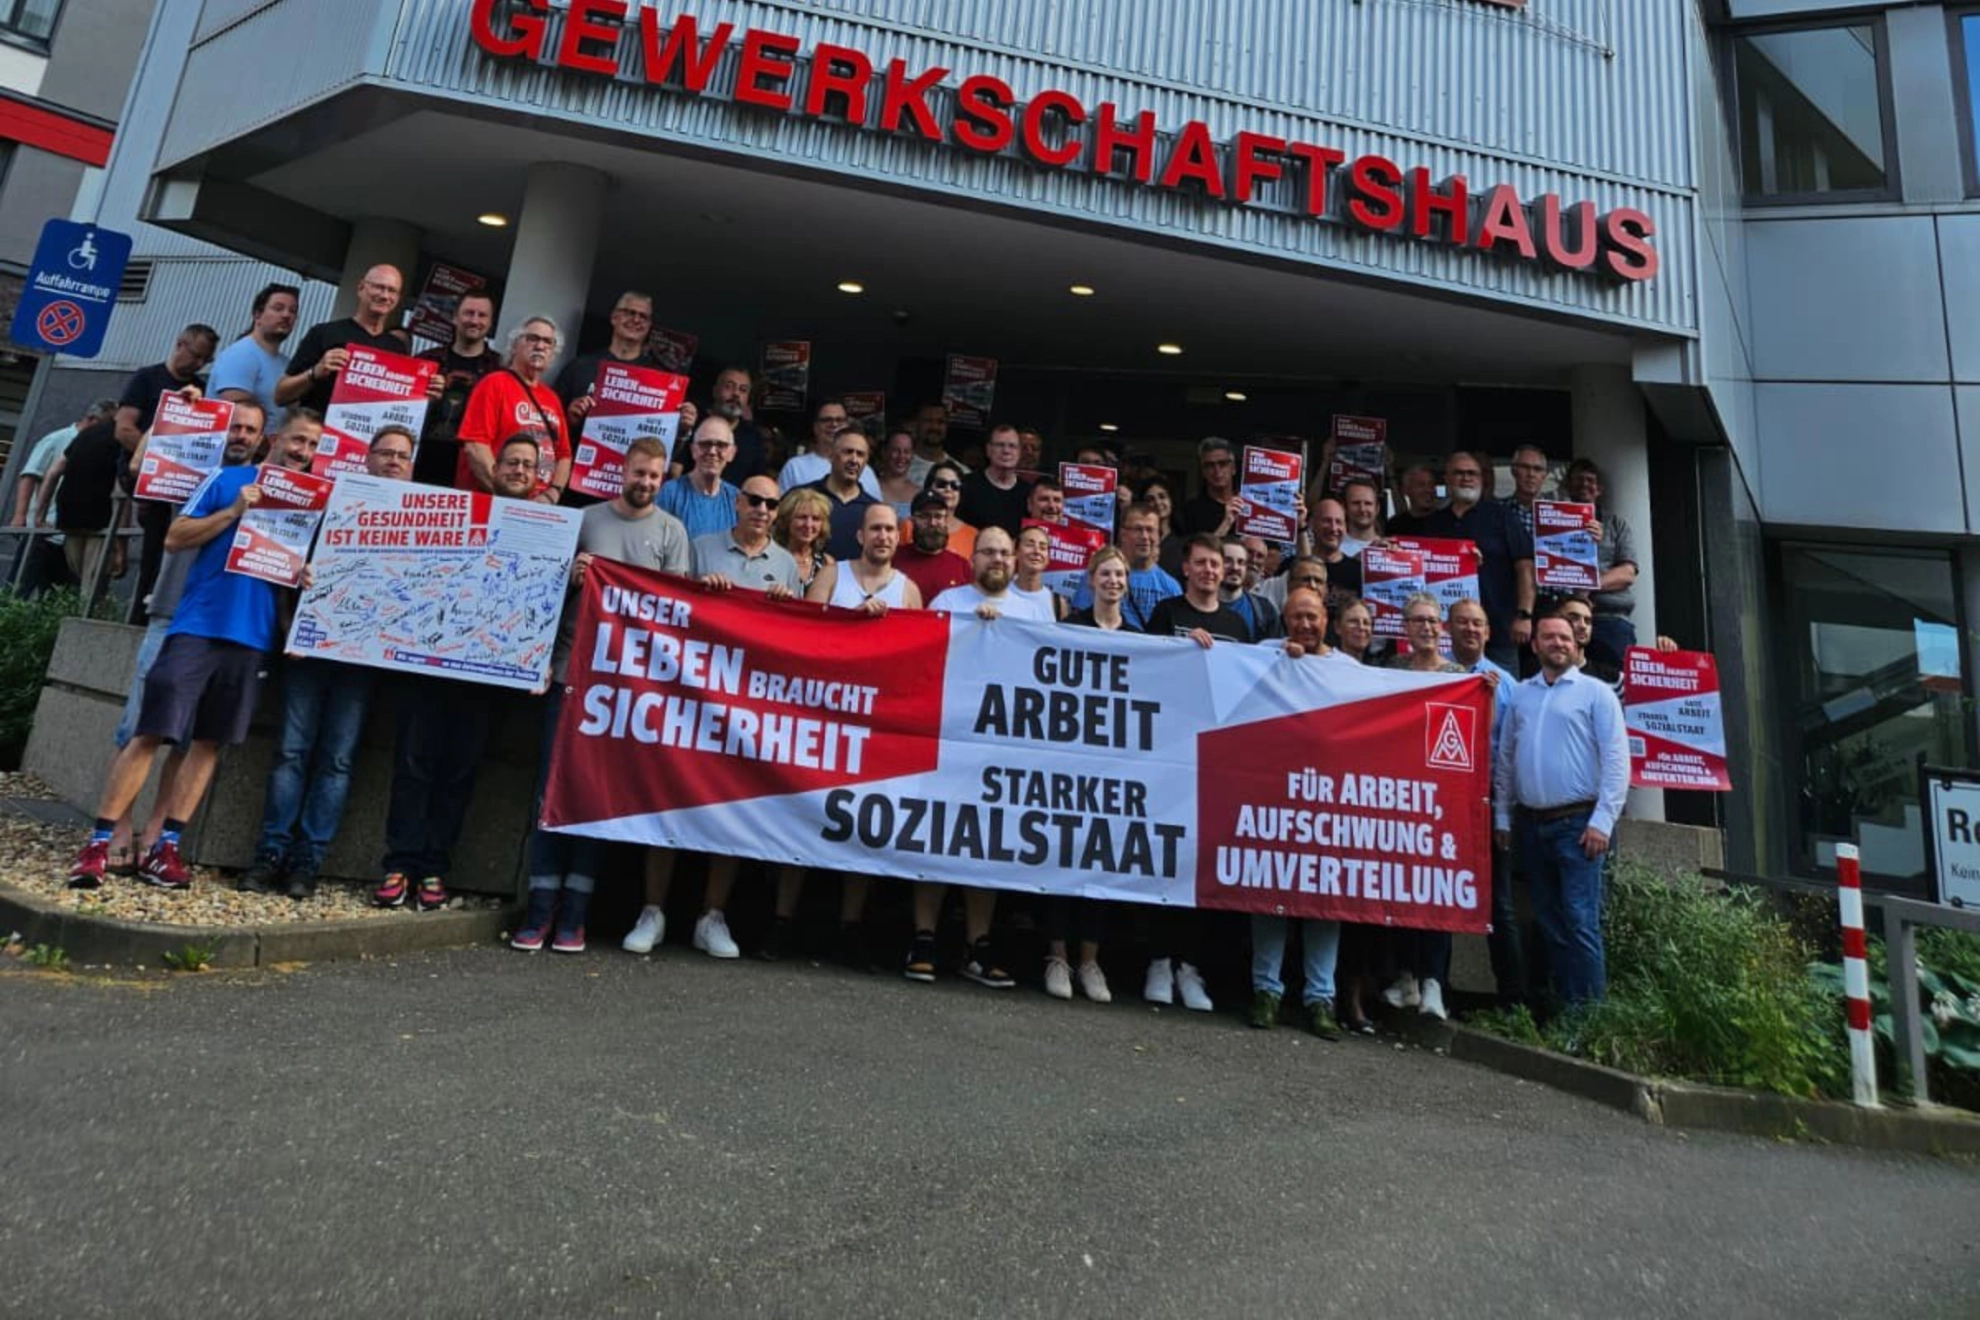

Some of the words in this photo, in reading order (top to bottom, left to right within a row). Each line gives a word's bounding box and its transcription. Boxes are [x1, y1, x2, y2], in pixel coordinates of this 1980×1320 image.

[470, 0, 1658, 281] GEWERKSCHAFTSHAUS
[35, 271, 110, 298] Auffahrrampe
[349, 360, 386, 376] LEBEN
[345, 373, 413, 396] SICHERHEIT
[604, 376, 639, 391] LEBEN
[601, 387, 665, 409] SICHERHEIT
[402, 493, 469, 510] UNSERE
[357, 511, 467, 528] GESUNDHEIT
[325, 529, 354, 546] IST
[358, 530, 410, 546] KEINE
[415, 530, 465, 546] WARE
[602, 585, 691, 628] UNSER
[592, 622, 744, 696] LEBEN
[748, 670, 878, 716] BRAUCHT
[1033, 646, 1130, 693] GUTE
[1630, 660, 1665, 674] LEBEN
[1630, 674, 1699, 691] SICHERHEIT
[974, 684, 1161, 751] ARBEIT
[1679, 707, 1710, 719] ARBEIT
[578, 684, 871, 775] SICHERHEIT
[1645, 720, 1705, 735] SOZIALSTAAT
[981, 766, 1147, 818] STARKER
[1287, 767, 1334, 803] FÜR
[1339, 773, 1443, 820] ARBEIT,
[820, 789, 1186, 878] SOZIALSTAAT
[1235, 804, 1433, 857] AUFSCHWUNG
[1439, 833, 1457, 860] &
[1216, 846, 1477, 909] UMVERTEILUNG
